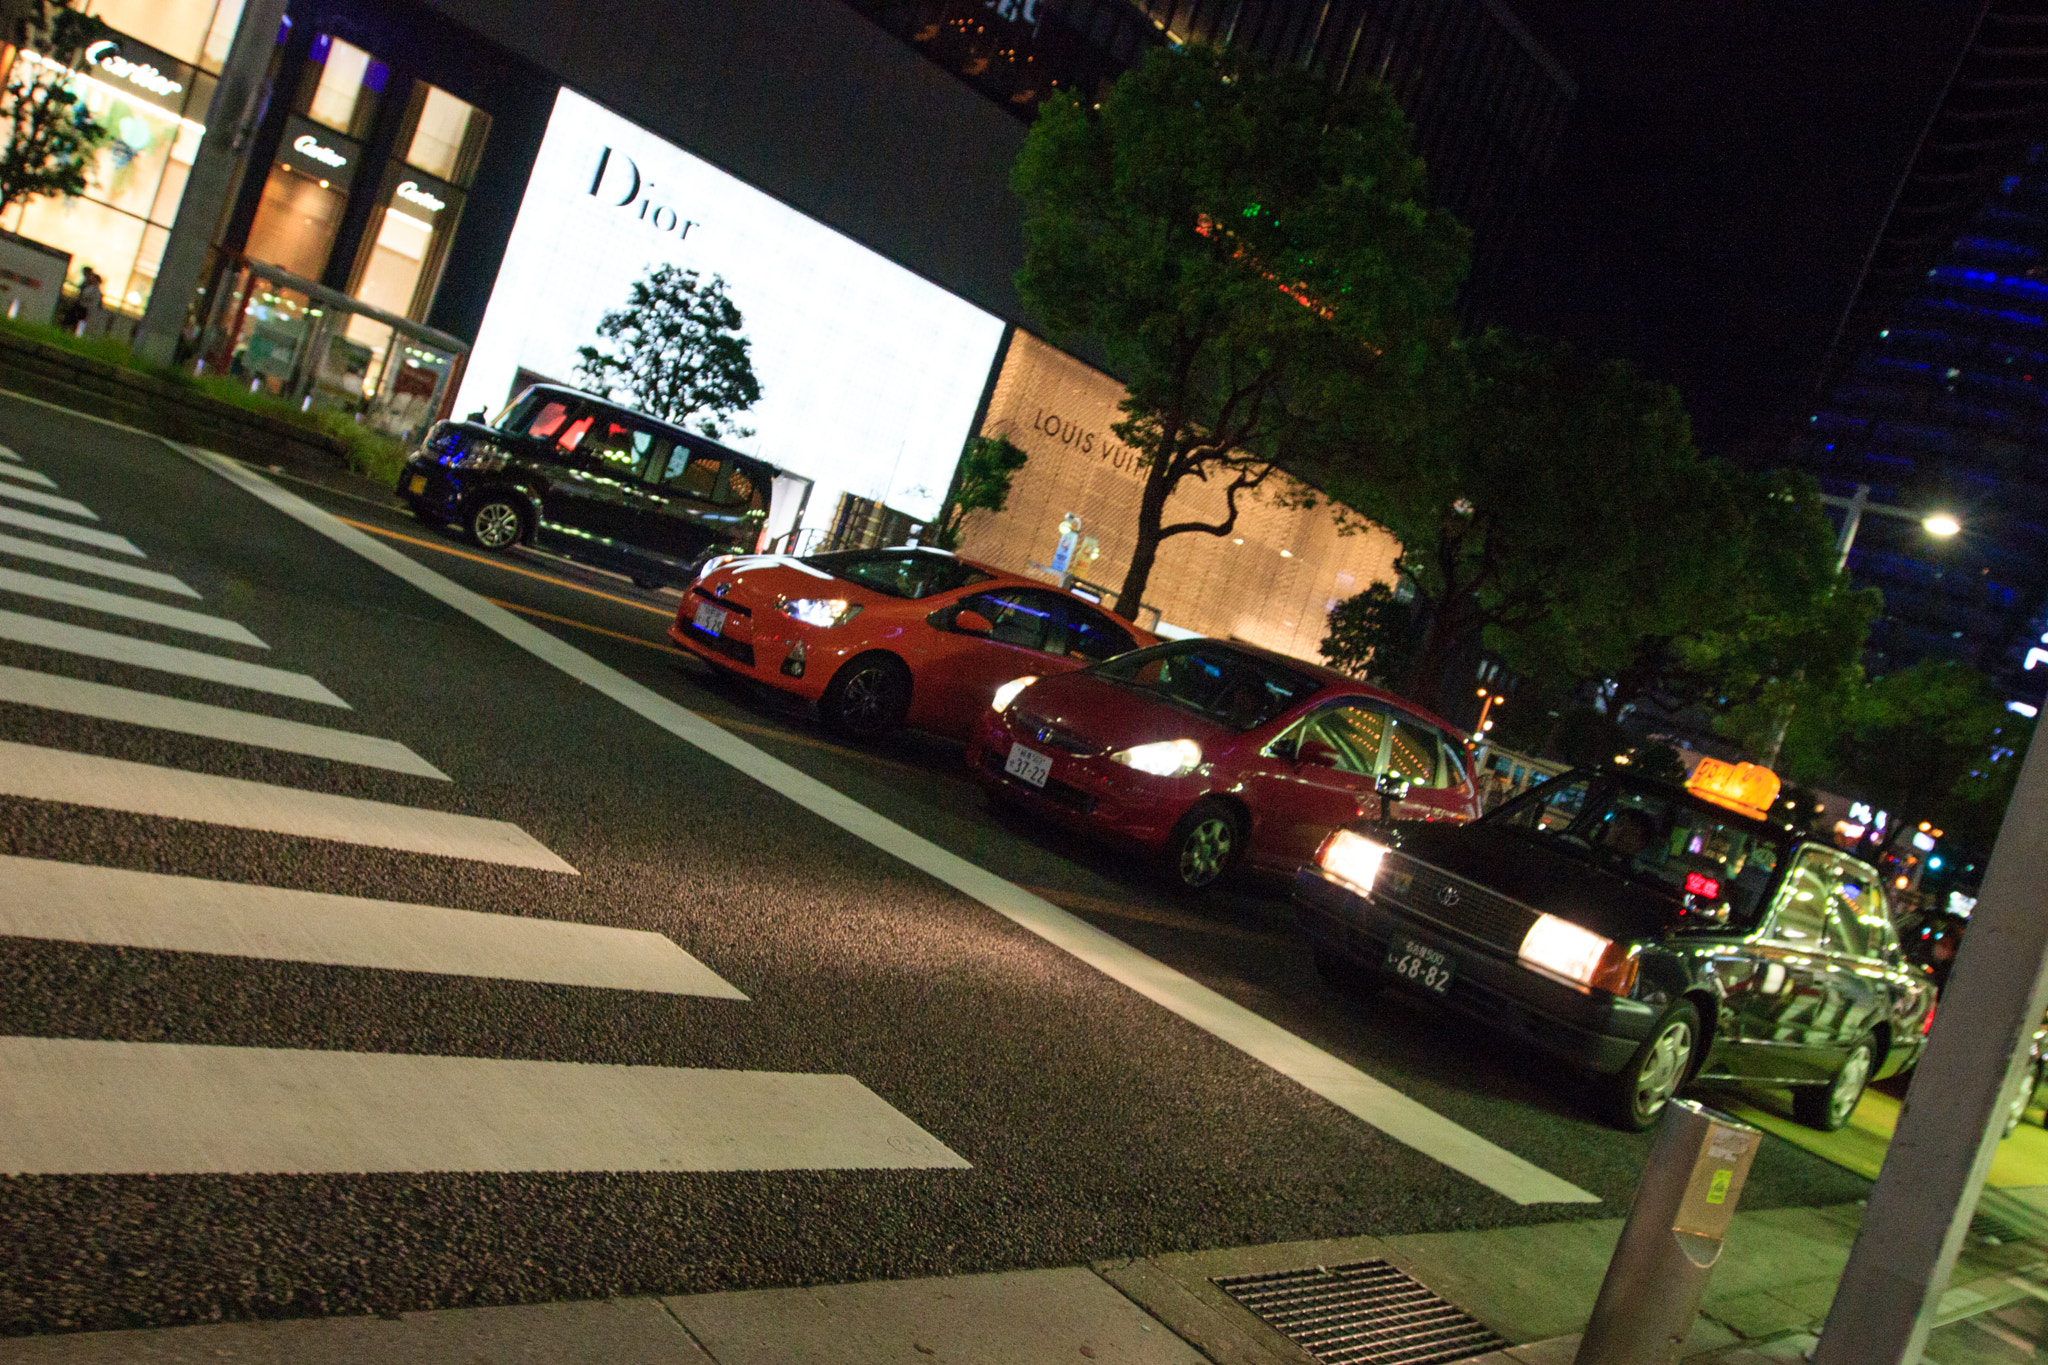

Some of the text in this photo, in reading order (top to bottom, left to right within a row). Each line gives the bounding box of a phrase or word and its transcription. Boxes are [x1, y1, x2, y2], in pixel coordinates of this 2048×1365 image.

[84, 39, 183, 97] Cartier
[293, 134, 347, 168] Cartier
[396, 180, 446, 212] Cartier
[588, 144, 701, 241] Dior
[1033, 408, 1095, 453] LOUIS
[1397, 954, 1450, 992] 68-82
